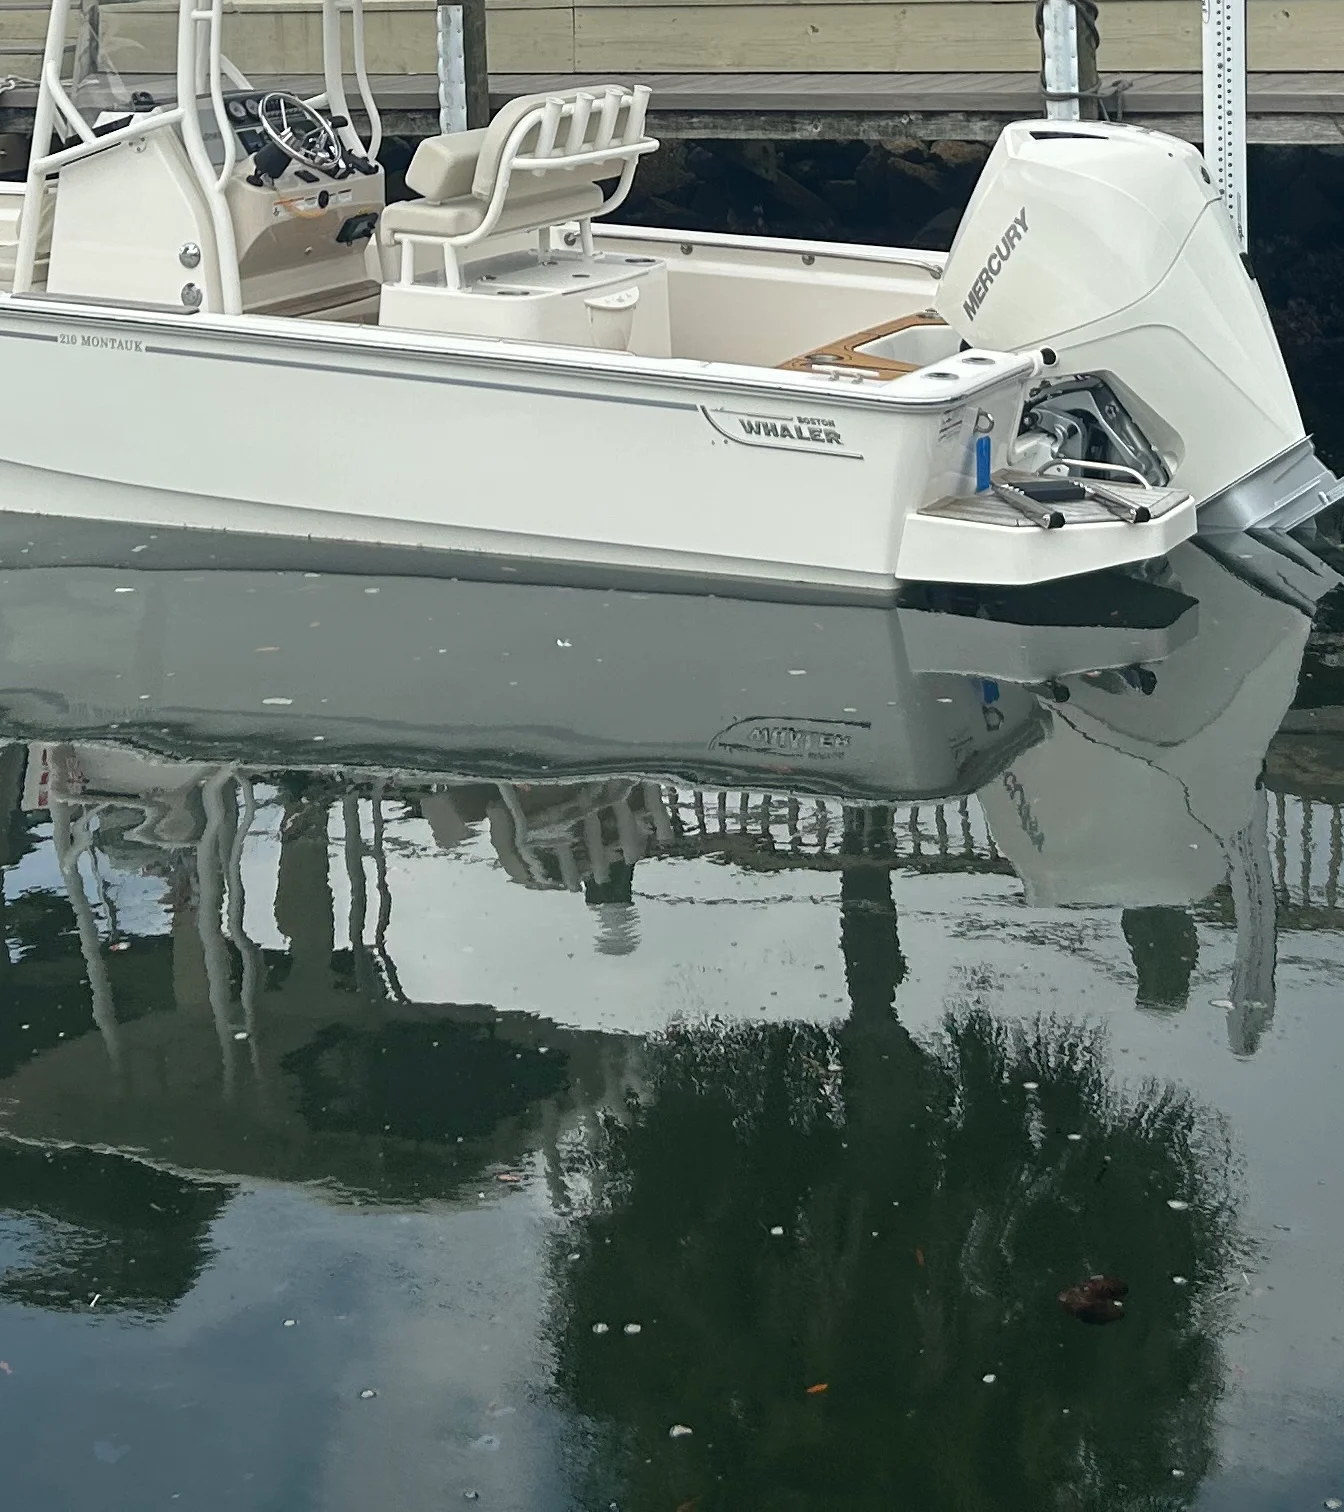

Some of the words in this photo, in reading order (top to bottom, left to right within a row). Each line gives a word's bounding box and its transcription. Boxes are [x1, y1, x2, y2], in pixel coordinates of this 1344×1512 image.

[962, 206, 1029, 322] MERCURY
[59, 333, 77, 345] 210
[81, 334, 143, 352] MONTAUK
[739, 418, 844, 445] WHALER
[796, 416, 836, 428] BOSTON
